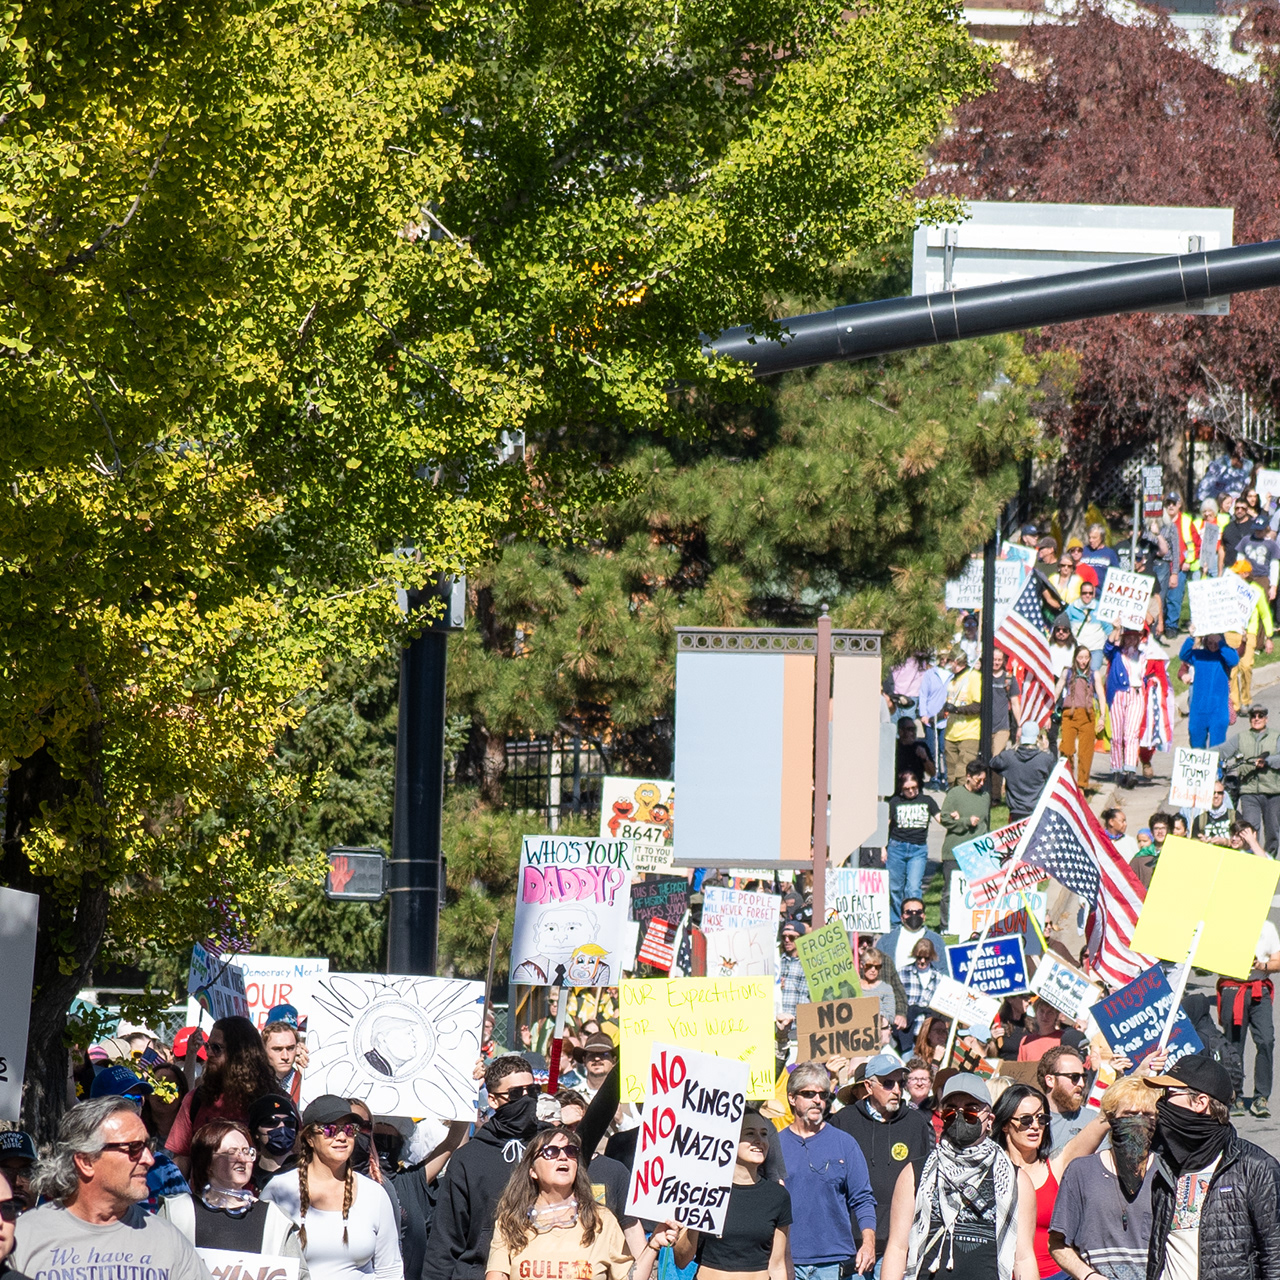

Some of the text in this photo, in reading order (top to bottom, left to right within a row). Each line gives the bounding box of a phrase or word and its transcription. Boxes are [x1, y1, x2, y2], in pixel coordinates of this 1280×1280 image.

[1110, 572, 1149, 588] ELECT A
[1107, 582, 1149, 602] RAPIST
[1104, 595, 1143, 611] EXPECT TO
[1179, 749, 1211, 765] Donald
[1179, 764, 1210, 781] Trump
[1187, 777, 1193, 786] is
[622, 824, 662, 842] 8647
[524, 839, 631, 870] WHO'S YOUR
[645, 846, 670, 856] TO YOU
[973, 837, 995, 856] NO
[637, 855, 668, 864] LETTERS
[522, 865, 625, 906] DADDY?
[632, 886, 647, 899] THIS
[649, 885, 657, 897] IS
[859, 870, 885, 895] MAGA
[982, 879, 1000, 901] IN
[634, 898, 644, 909] OF
[705, 888, 772, 908] WE THE PEOPLE
[851, 894, 874, 912] FACT
[636, 905, 663, 920] MAKES
[703, 914, 724, 927] THOSE
[728, 917, 738, 928] IN
[704, 903, 776, 920] WILL NEVER FORGET
[843, 912, 882, 930] YOURSELF
[801, 925, 843, 956] FROGS
[806, 942, 848, 970] TOGETHER
[959, 954, 1015, 972] AMERICA
[811, 957, 853, 987] STRONG
[973, 968, 1004, 981] KIND
[972, 978, 1010, 992] AGAIN
[312, 975, 370, 1026] NO
[623, 984, 656, 1006] OUR
[817, 1002, 853, 1029] NO
[623, 1017, 655, 1037] FOR
[809, 1013, 881, 1059] KINGS!
[651, 1051, 687, 1095] NO
[681, 1079, 744, 1123] KINGS
[2, 1142, 22, 1150] MUSIC
[642, 1105, 735, 1168] NO NAZIS
[633, 1155, 664, 1205] NO
[674, 1207, 715, 1231] USA
[51, 1246, 152, 1266] We have a
[519, 1260, 569, 1279] GULF
